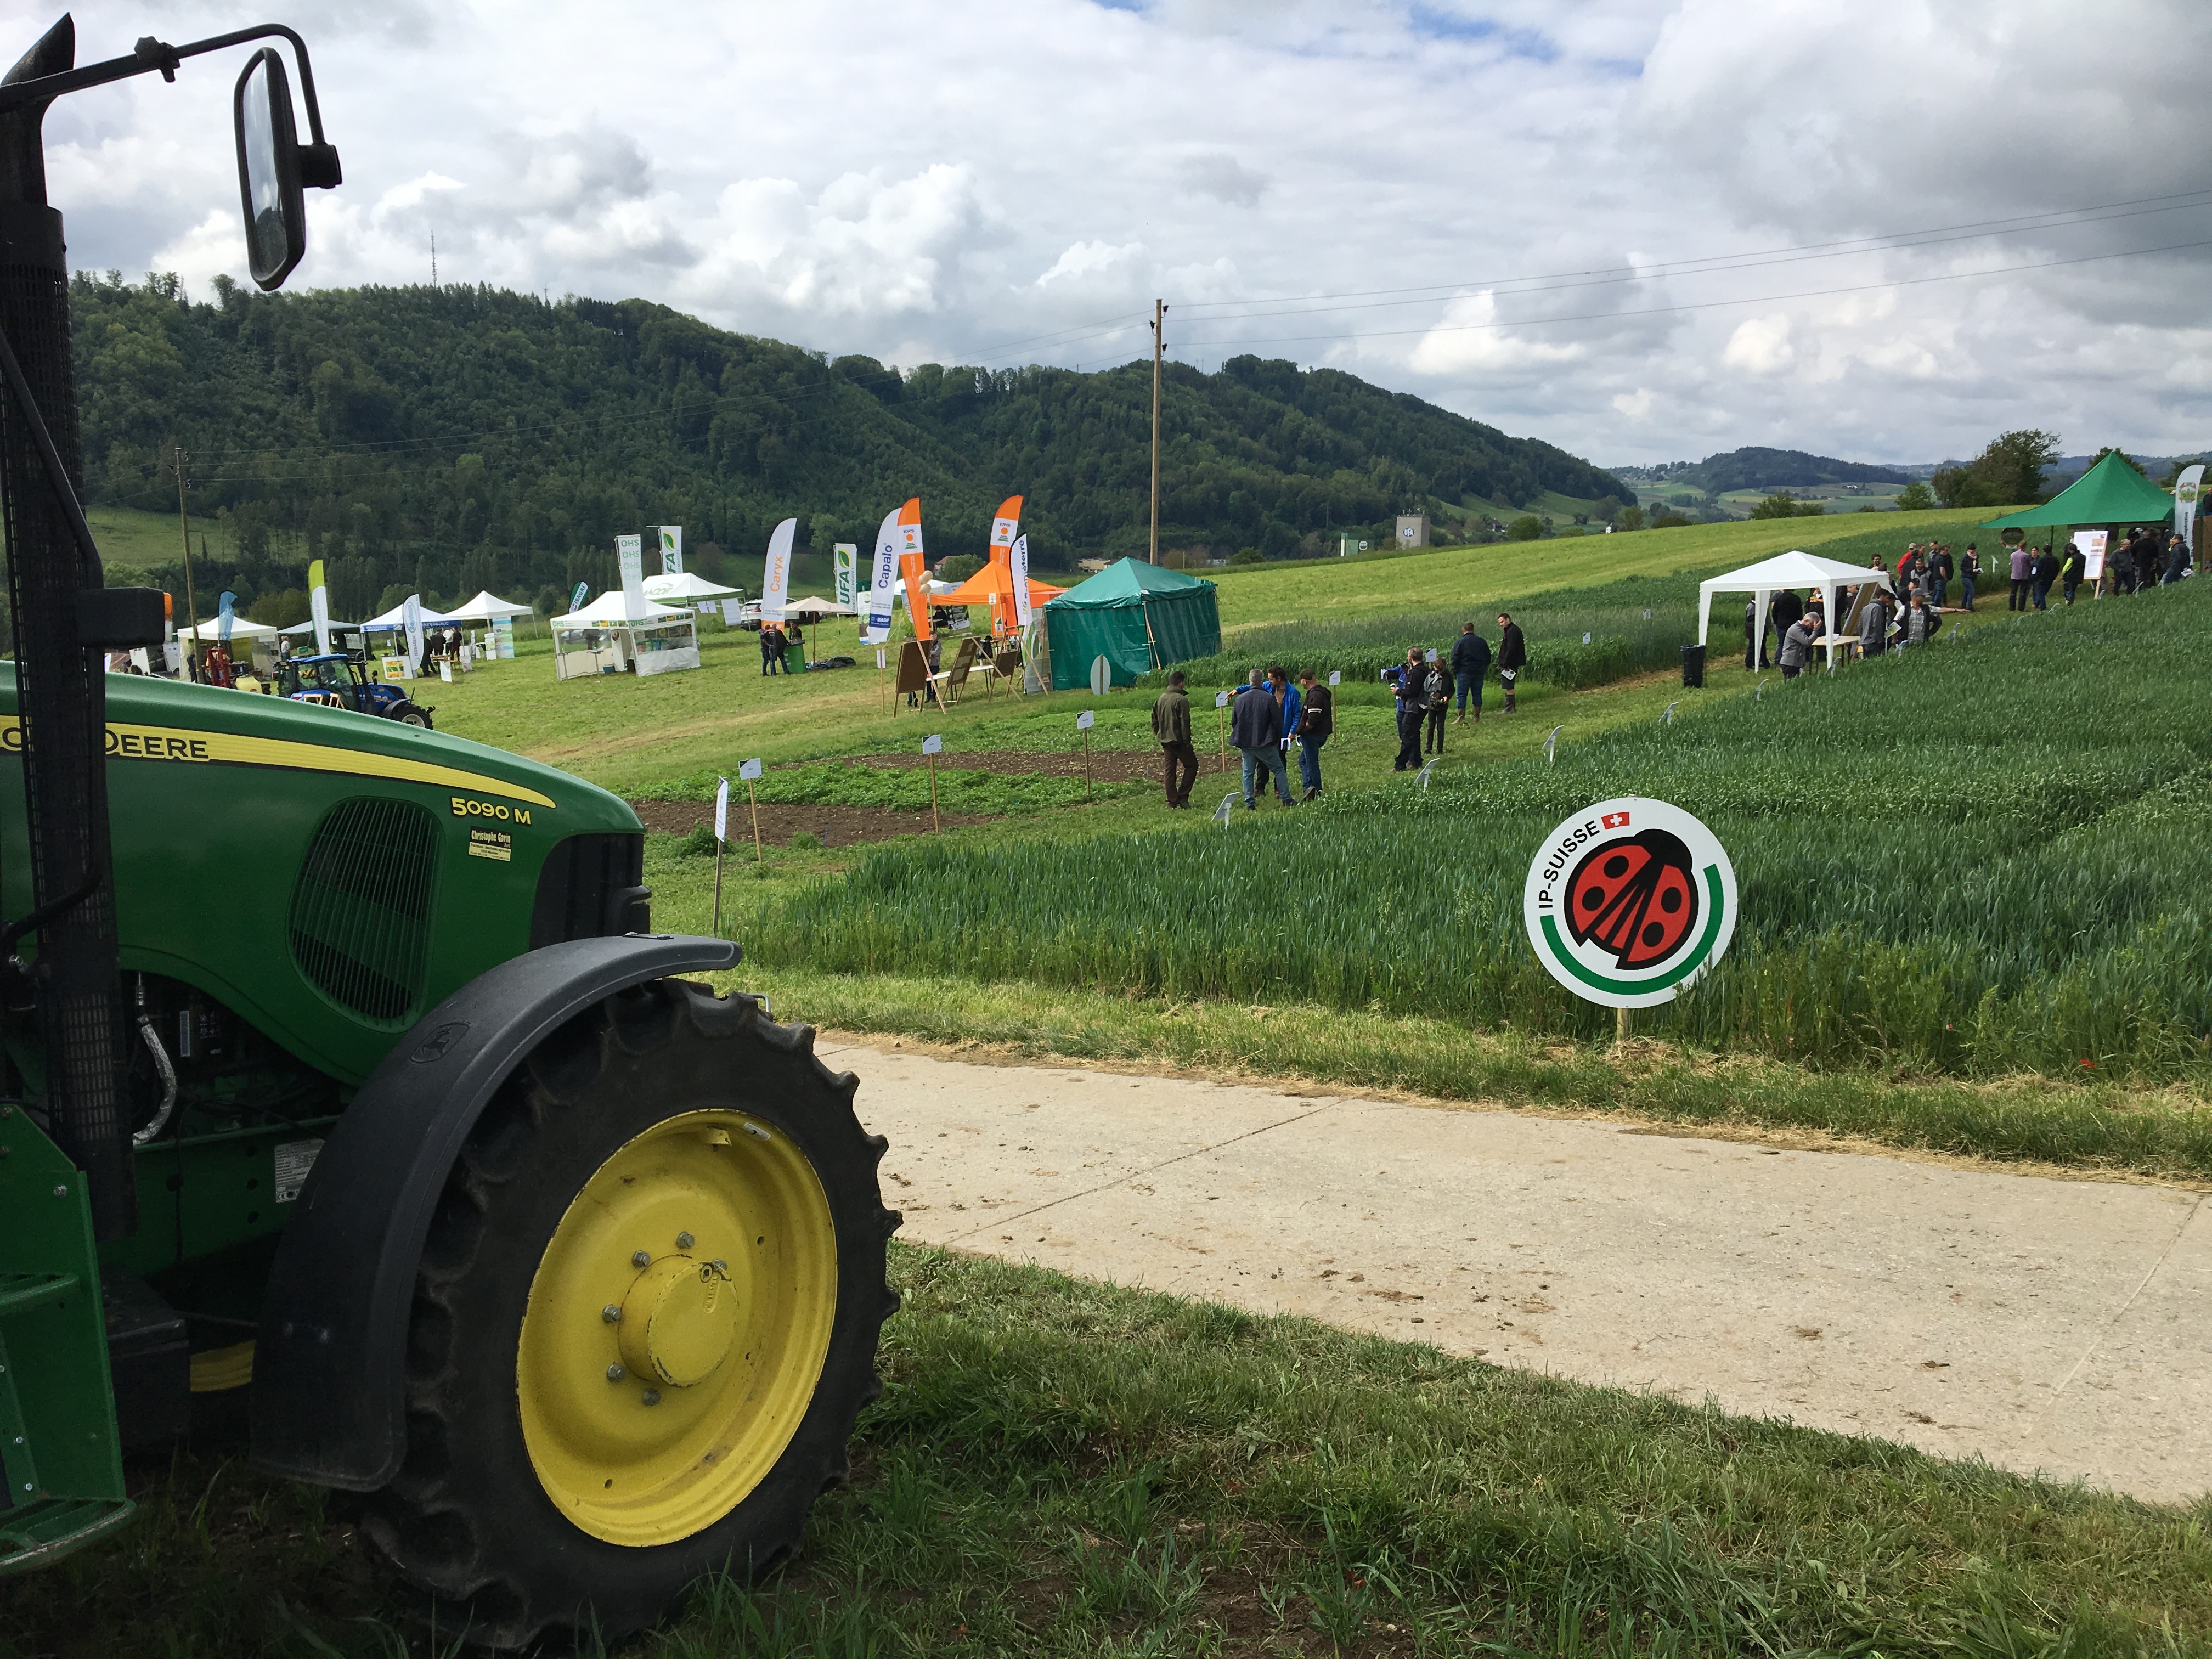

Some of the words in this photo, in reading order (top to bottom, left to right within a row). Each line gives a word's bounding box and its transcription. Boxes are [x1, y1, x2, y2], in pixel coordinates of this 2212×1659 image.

[1404, 528, 1413, 537] UFA
[621, 539, 639, 548] OHS
[622, 550, 640, 558] OHS
[666, 552, 676, 574] FA
[623, 561, 641, 569] OHS
[770, 555, 783, 592] Caryx
[878, 545, 893, 589] Capalo
[574, 585, 586, 604] ISAGRI
[643, 586, 674, 597] ANDOR
[839, 571, 850, 605] UFA
[315, 600, 319, 608] AG
[105, 729, 209, 759] DEERE
[452, 797, 509, 819] 5090
[514, 808, 531, 825] M
[471, 830, 496, 843] Christophe
[1538, 820, 1600, 909] IP-SUISSE
